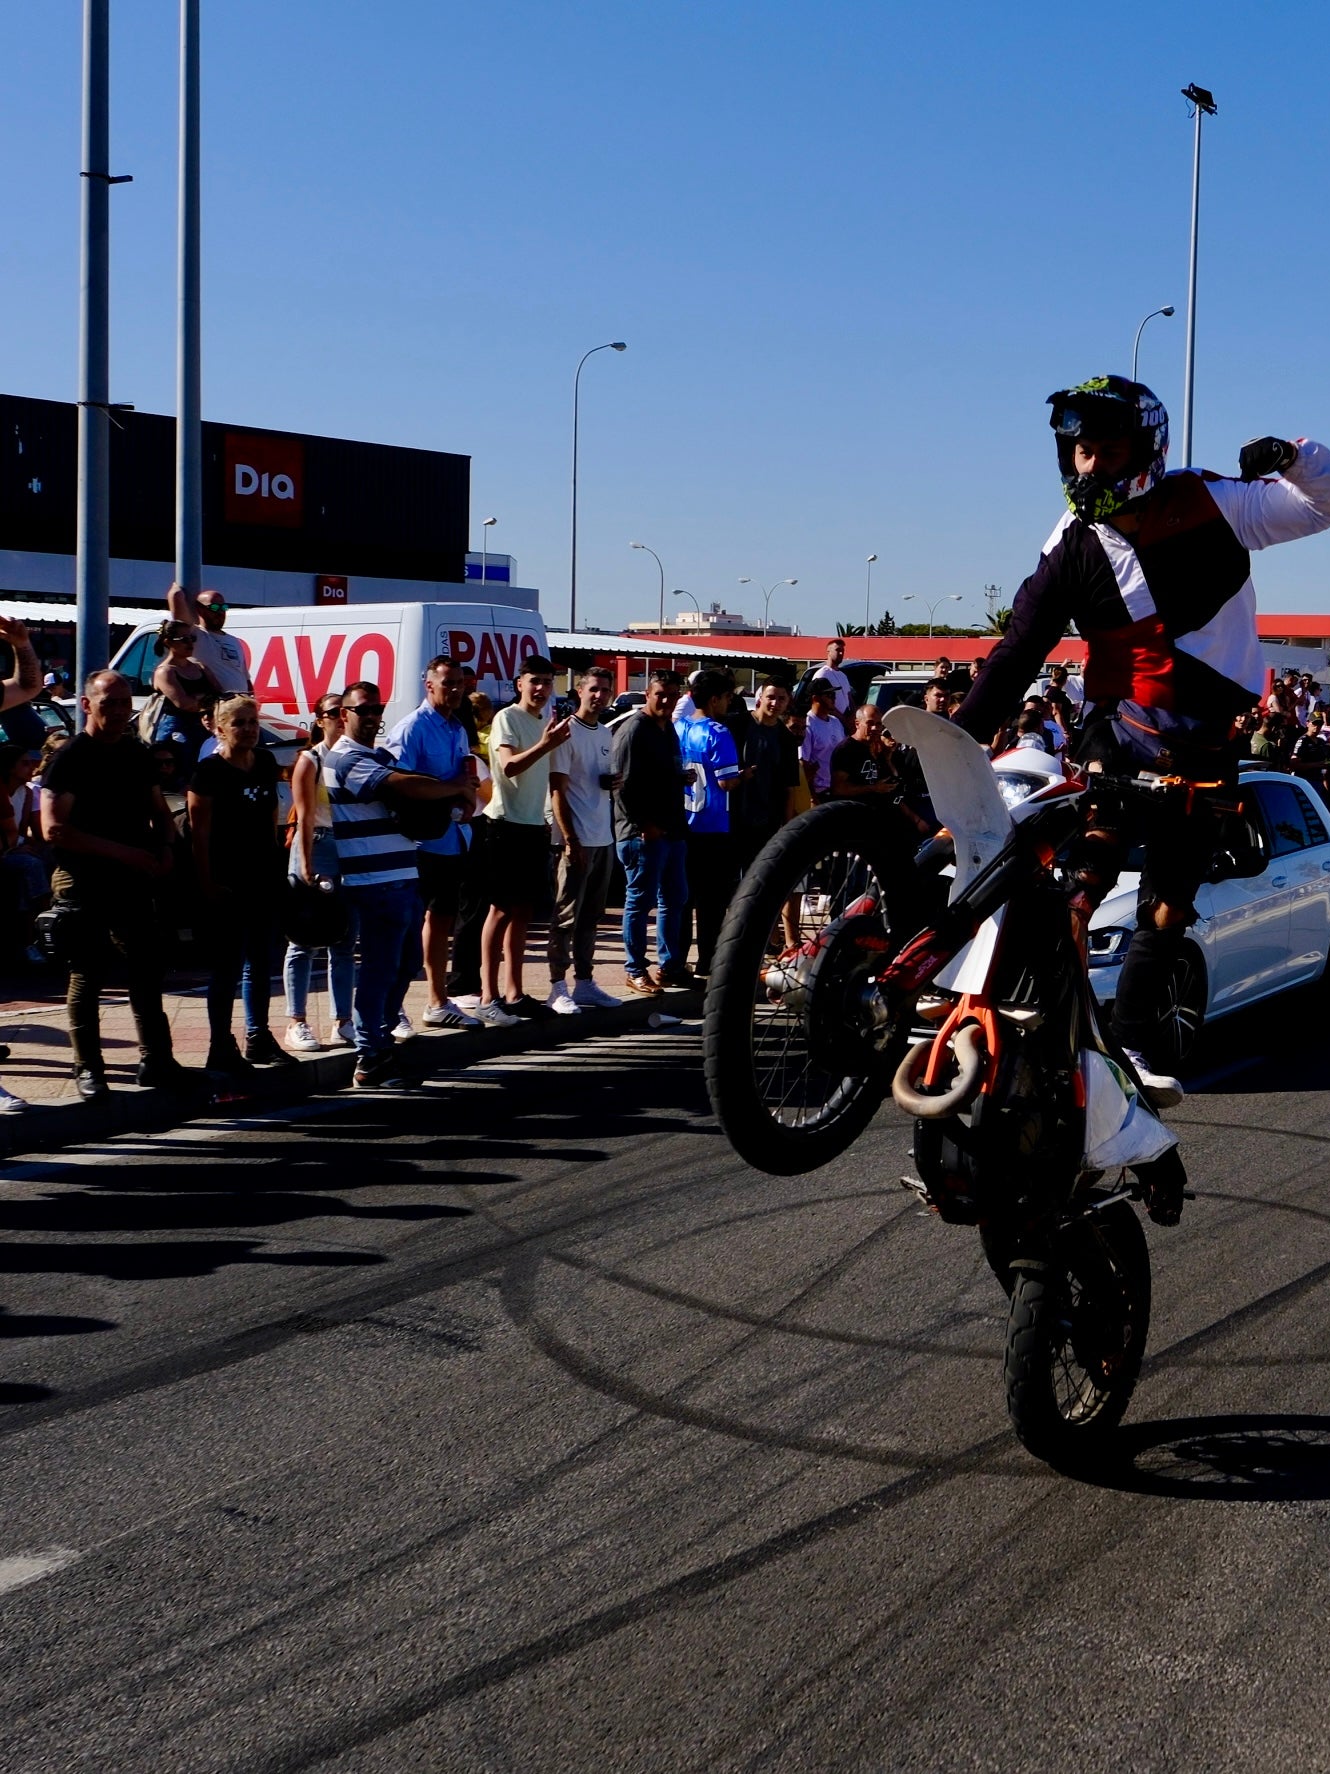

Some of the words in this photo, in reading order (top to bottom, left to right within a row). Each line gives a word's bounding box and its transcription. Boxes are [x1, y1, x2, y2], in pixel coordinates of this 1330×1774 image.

[235, 463, 295, 500] Dia
[323, 585, 345, 598] Dia
[236, 632, 395, 715] AVO
